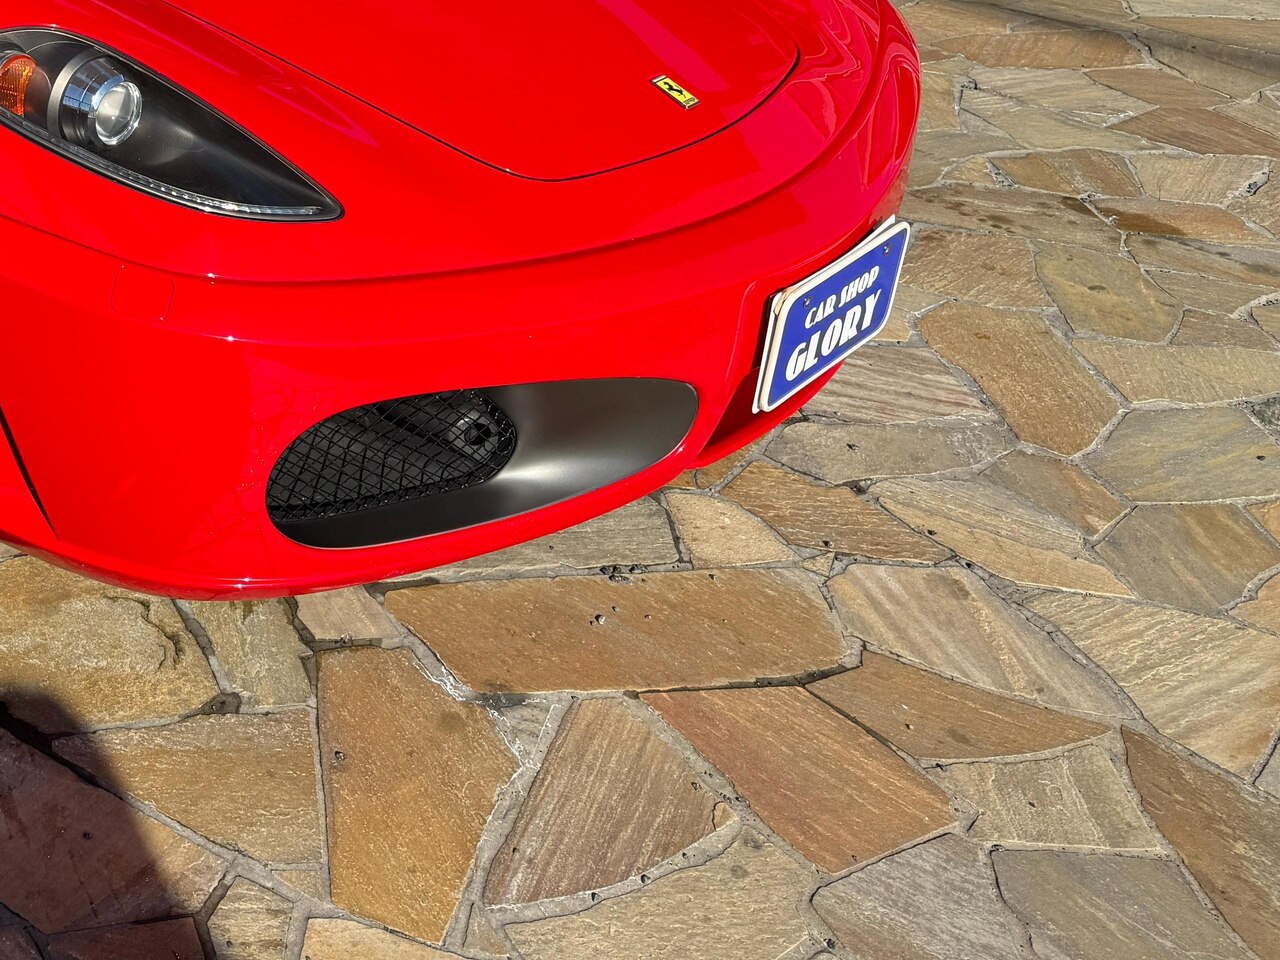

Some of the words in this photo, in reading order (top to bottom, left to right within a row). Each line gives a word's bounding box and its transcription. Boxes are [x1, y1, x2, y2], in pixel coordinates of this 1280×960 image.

[785, 288, 882, 382] GLORY
[804, 293, 837, 329] CAR
[838, 265, 880, 308] SHOP
